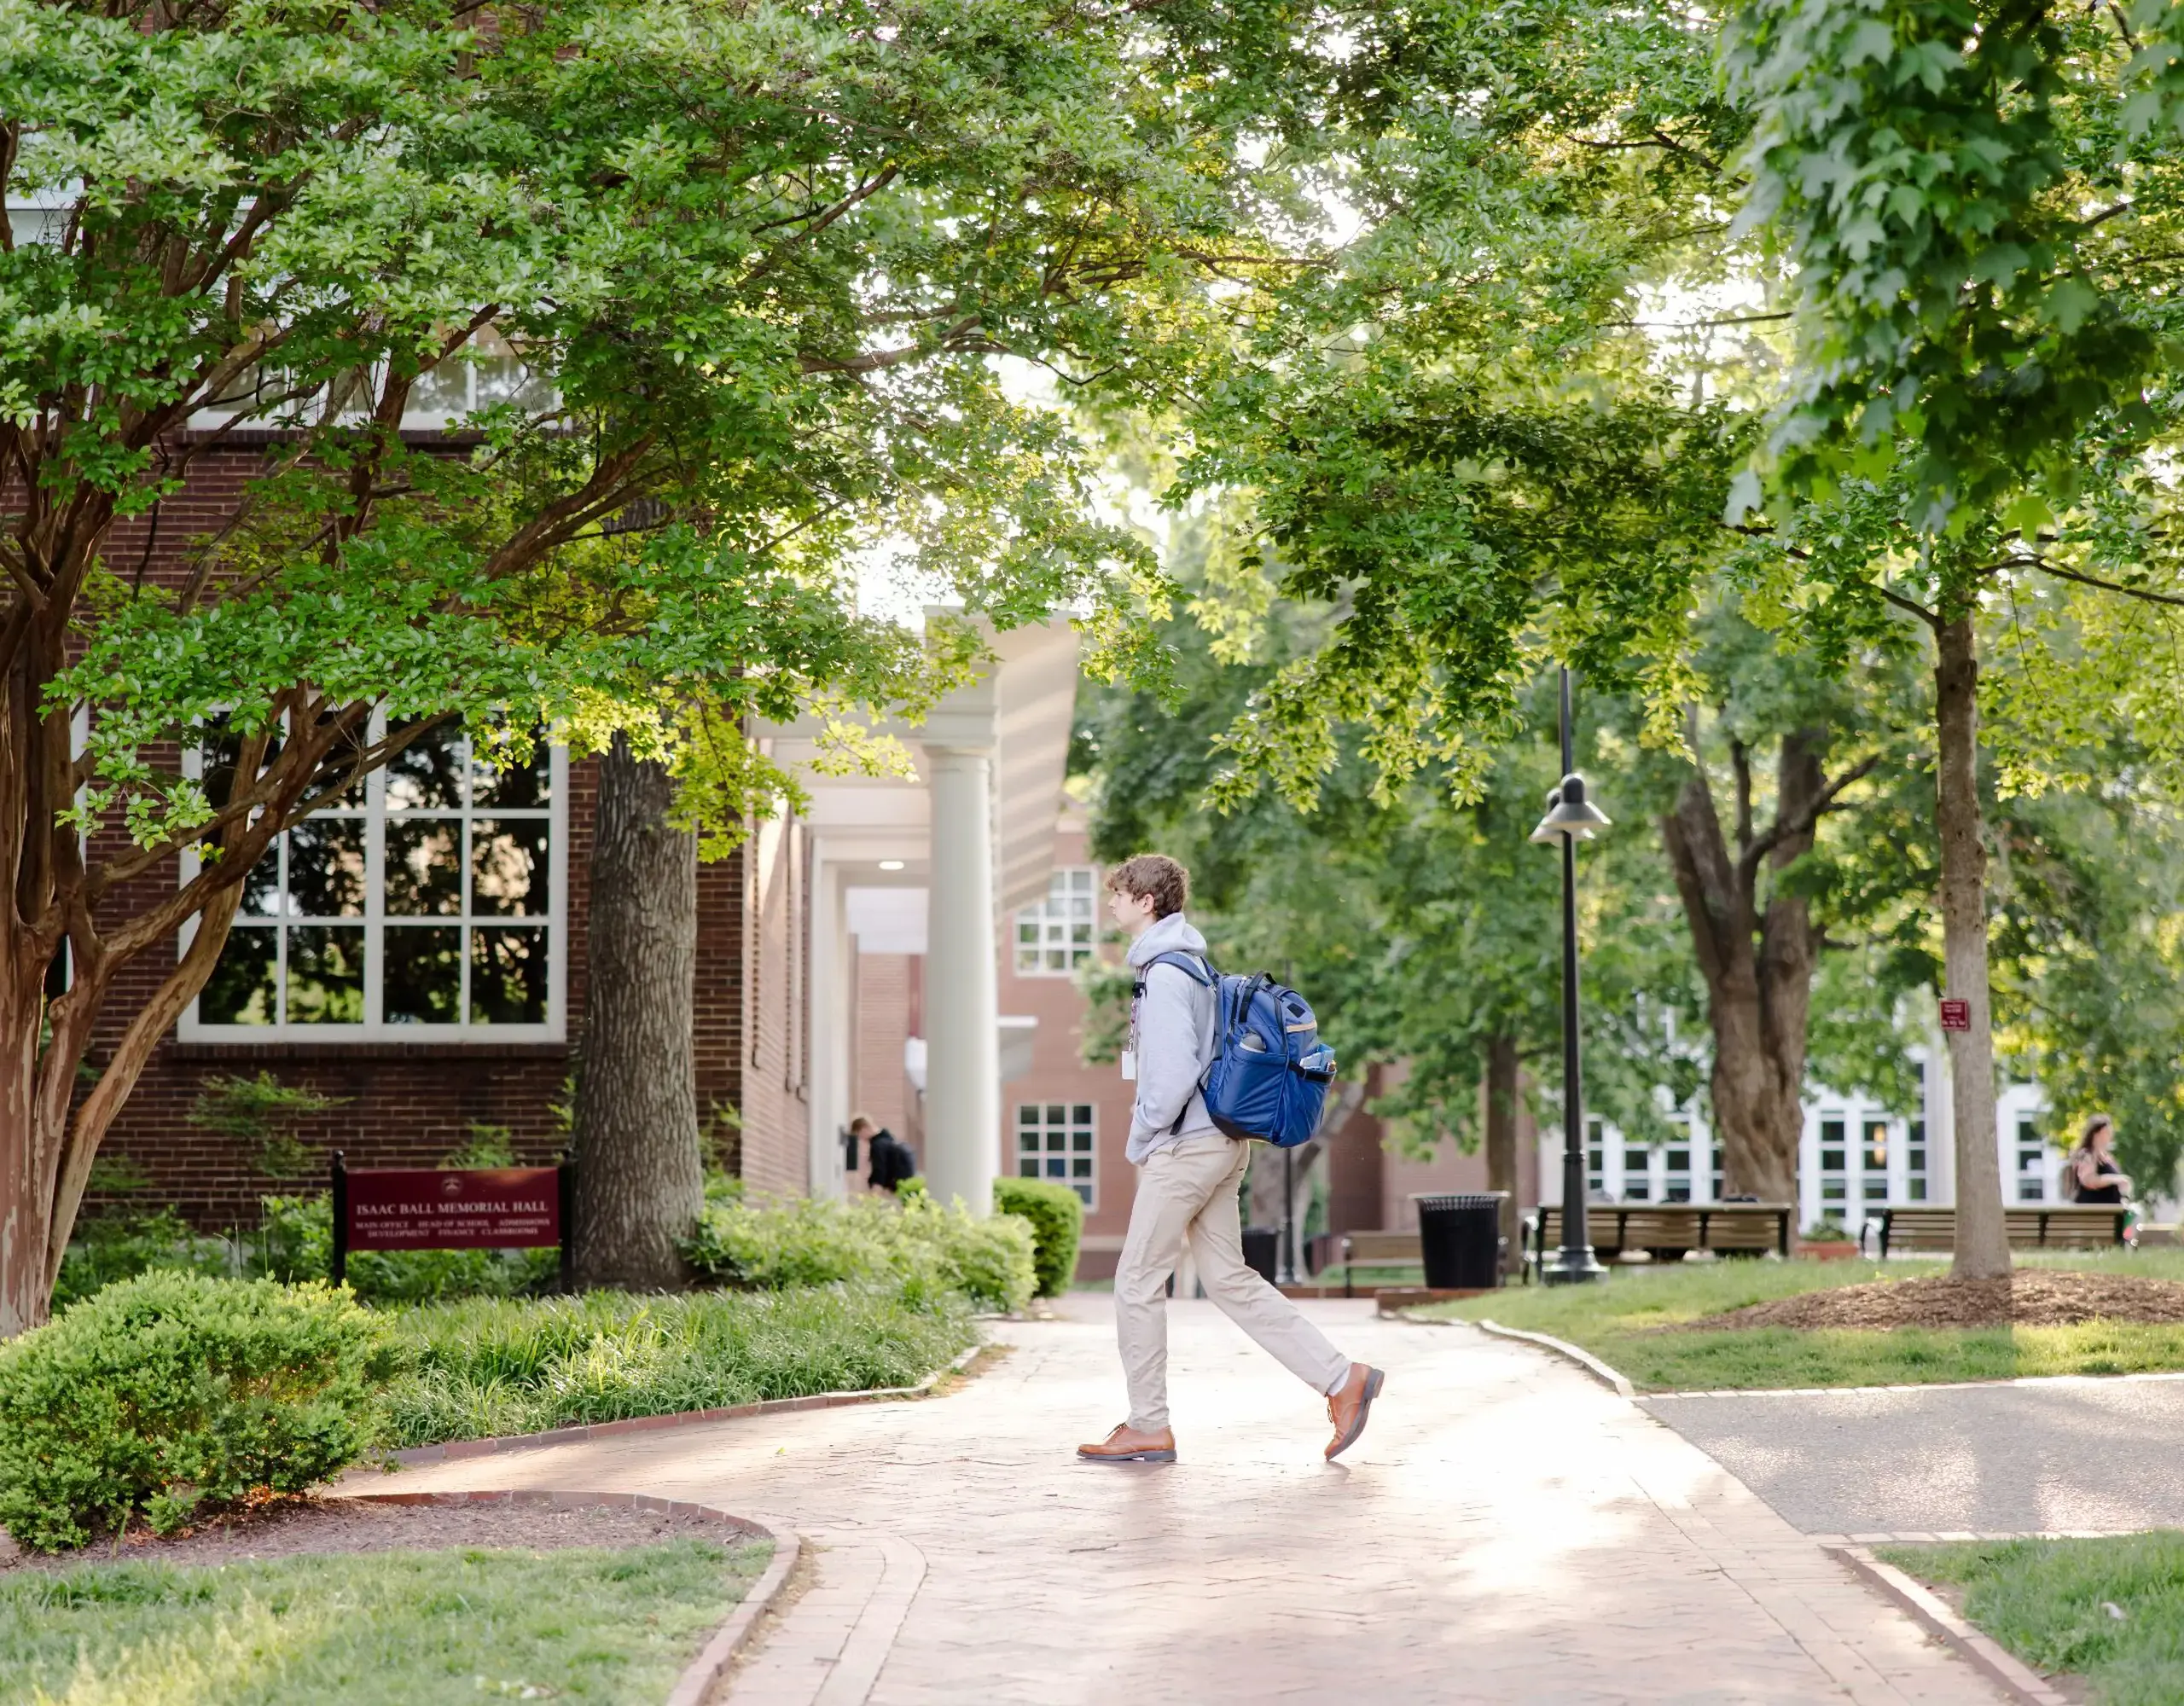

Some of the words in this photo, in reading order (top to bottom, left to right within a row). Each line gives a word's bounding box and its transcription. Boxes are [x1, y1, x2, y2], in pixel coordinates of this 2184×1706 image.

[357, 1204, 396, 1216] ISAAC
[399, 1202, 435, 1215] BALL
[437, 1201, 509, 1214] MEMORIAL
[512, 1200, 549, 1213] HALL
[456, 1219, 490, 1227] SCHOOL
[368, 1229, 430, 1238] DEVELOPMENT
[480, 1227, 538, 1236] CLASSROOMS
